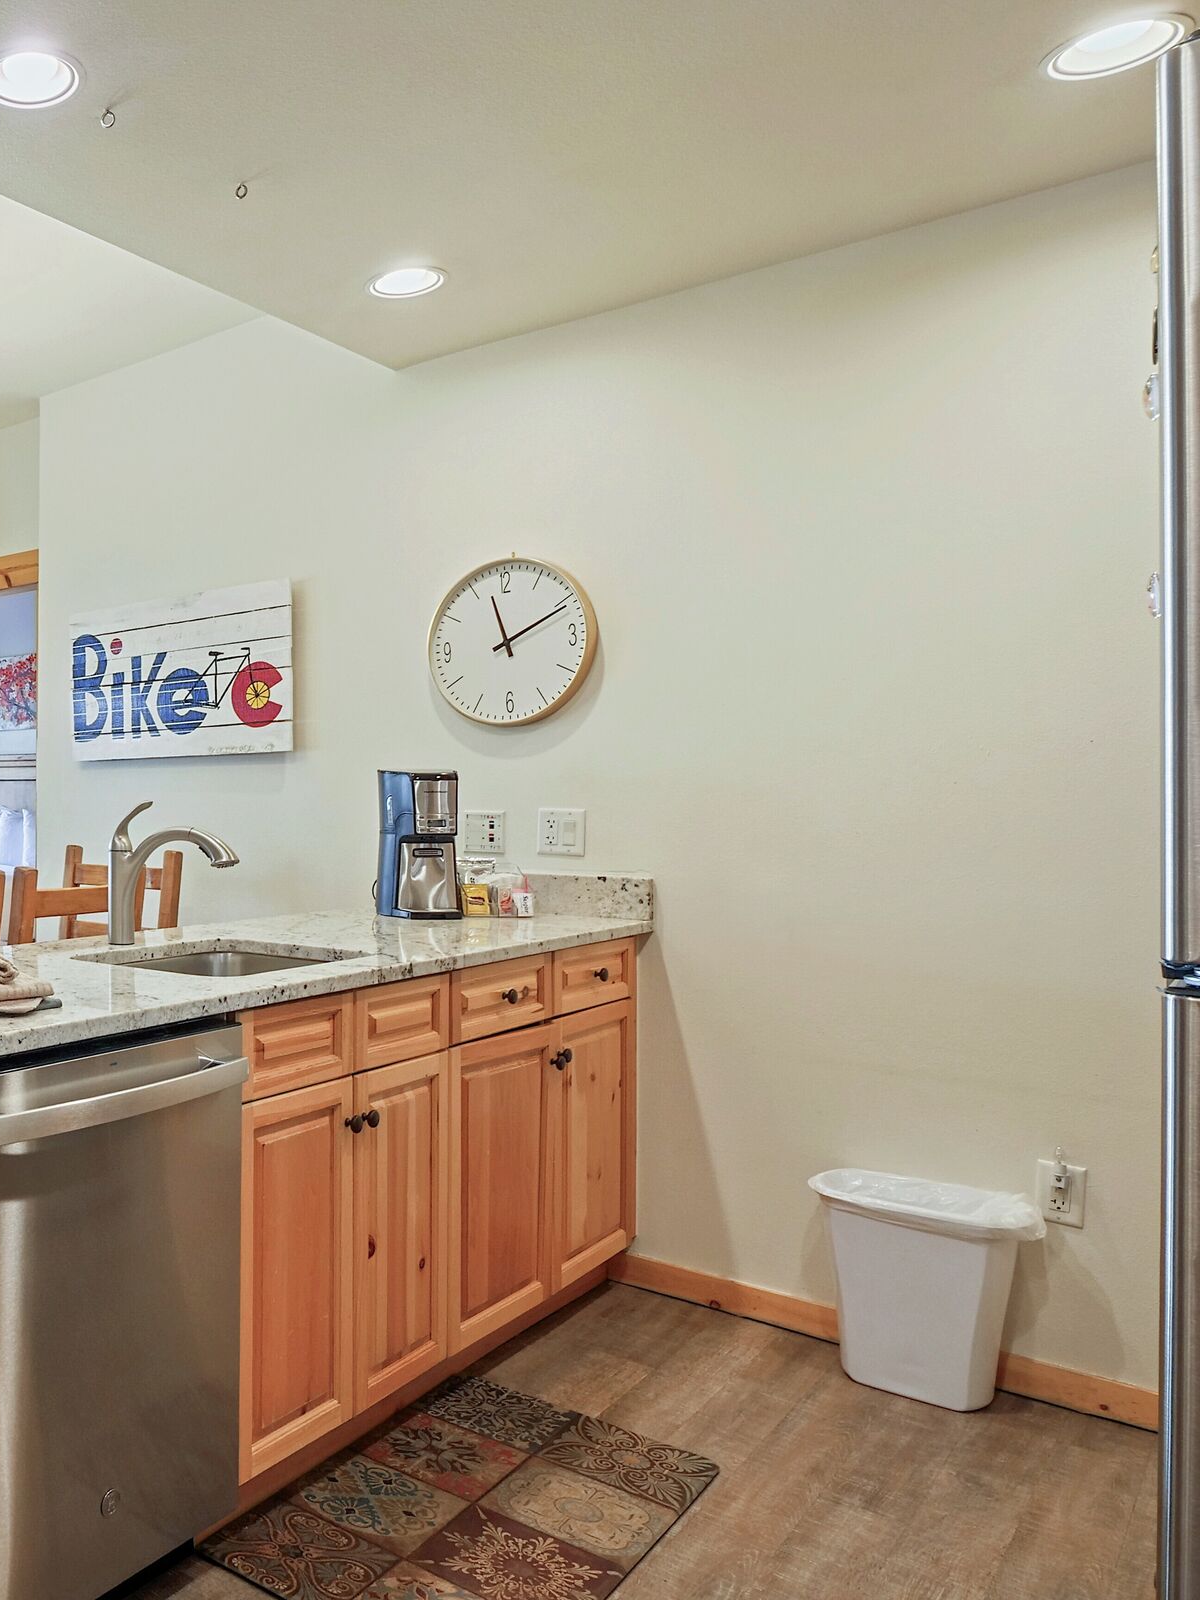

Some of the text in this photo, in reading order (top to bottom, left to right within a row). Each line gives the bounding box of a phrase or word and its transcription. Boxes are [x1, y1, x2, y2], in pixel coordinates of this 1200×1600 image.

[499, 571, 511, 594] 12
[568, 623, 577, 646] 3
[443, 642, 451, 663] 9
[231, 661, 283, 728] C
[505, 691, 514, 713] 6
